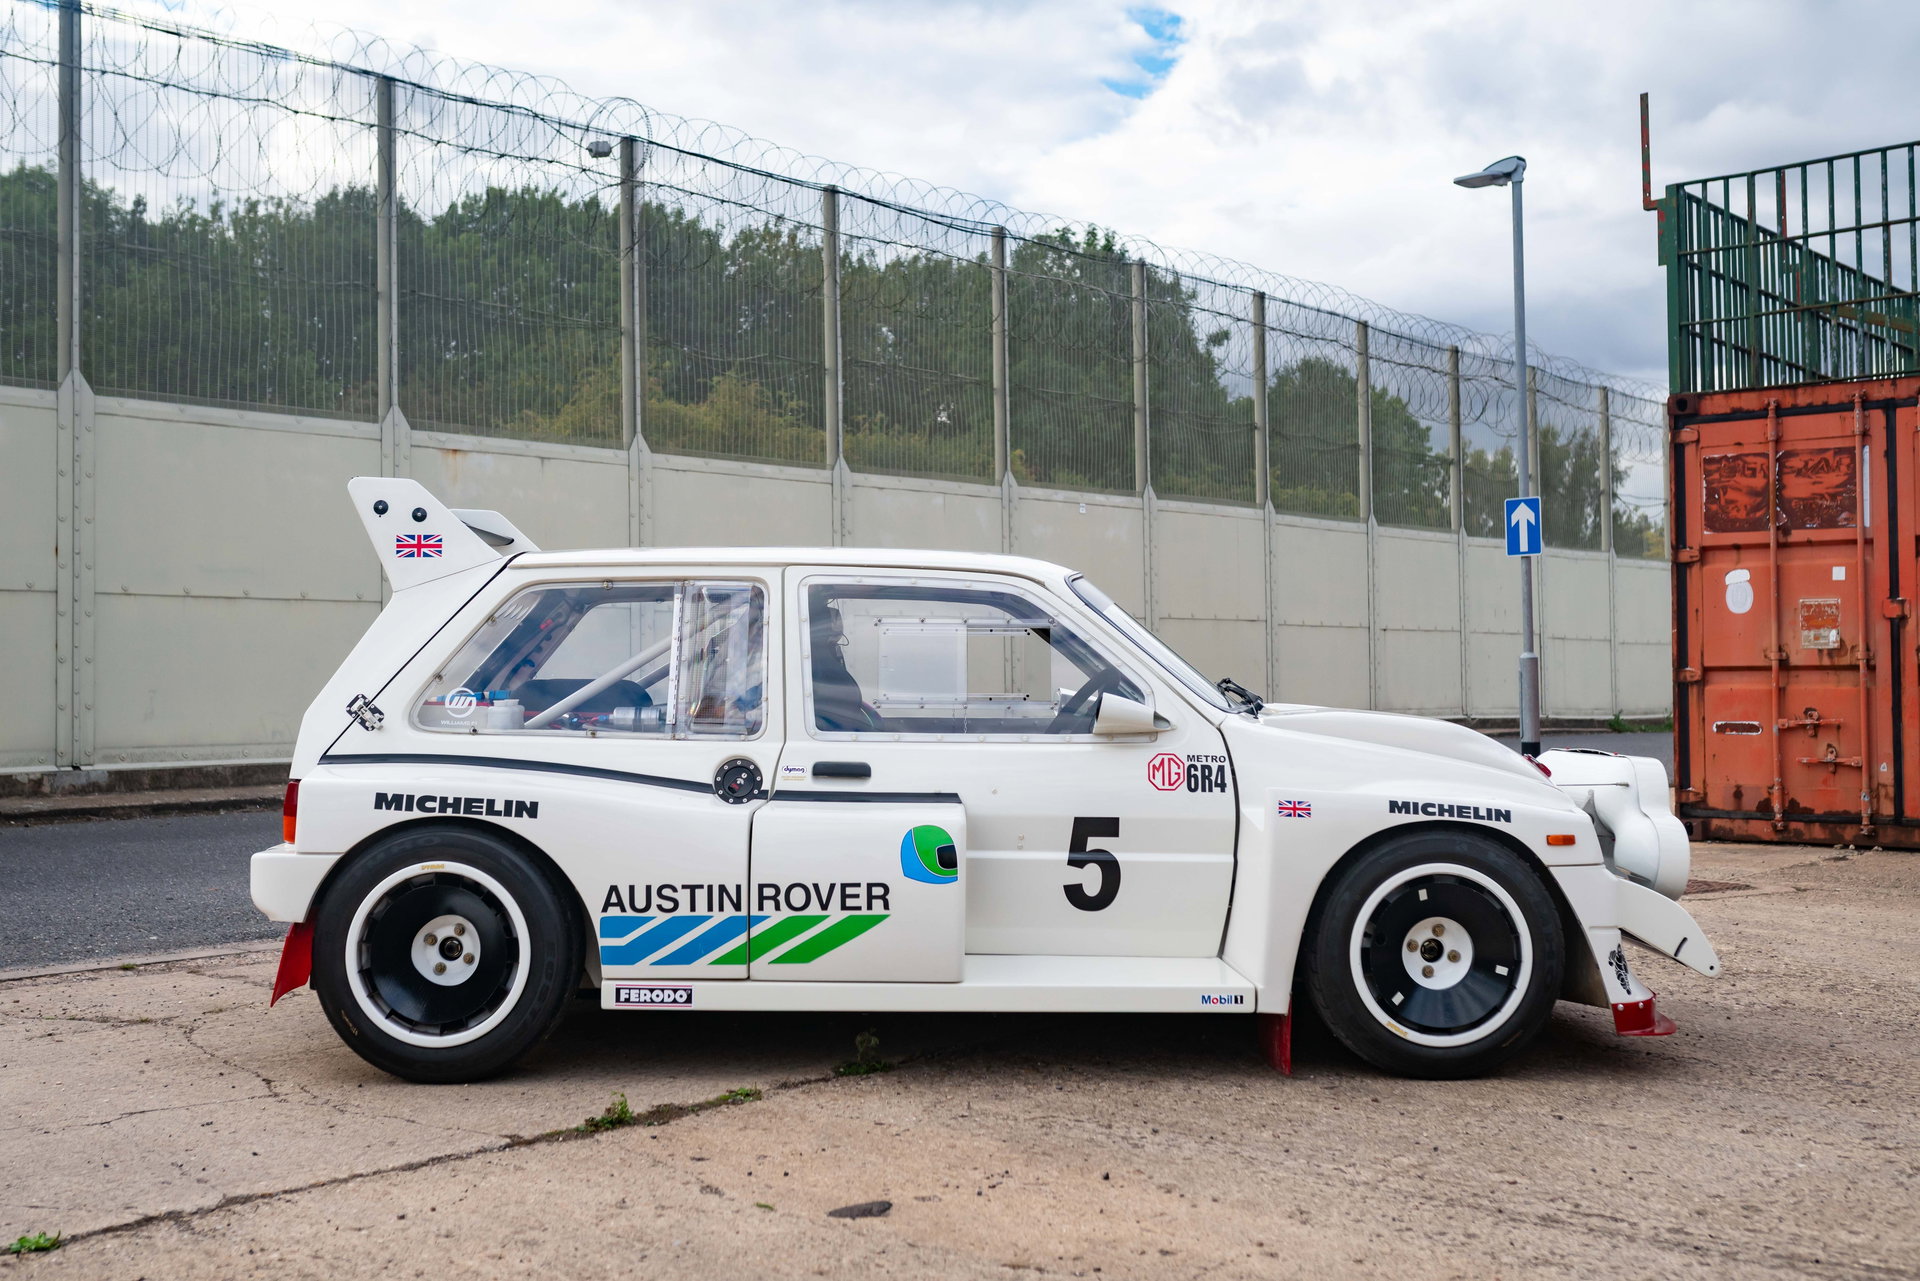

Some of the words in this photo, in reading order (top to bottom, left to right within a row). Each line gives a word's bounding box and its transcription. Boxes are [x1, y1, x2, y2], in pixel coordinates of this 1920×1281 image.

[1150, 755, 1183, 789] MG
[1186, 754, 1227, 764] METRO
[1186, 764, 1227, 793] 6R4
[374, 792, 539, 819] MICHELIN
[1388, 799, 1512, 824] MICHELIN
[1062, 816, 1122, 912] 5
[600, 884, 742, 914] AUSTIN
[757, 883, 890, 912] ROVER
[619, 988, 688, 1003] FERODO
[1201, 994, 1233, 1005] Mobil
[1234, 995, 1244, 1005] 1
